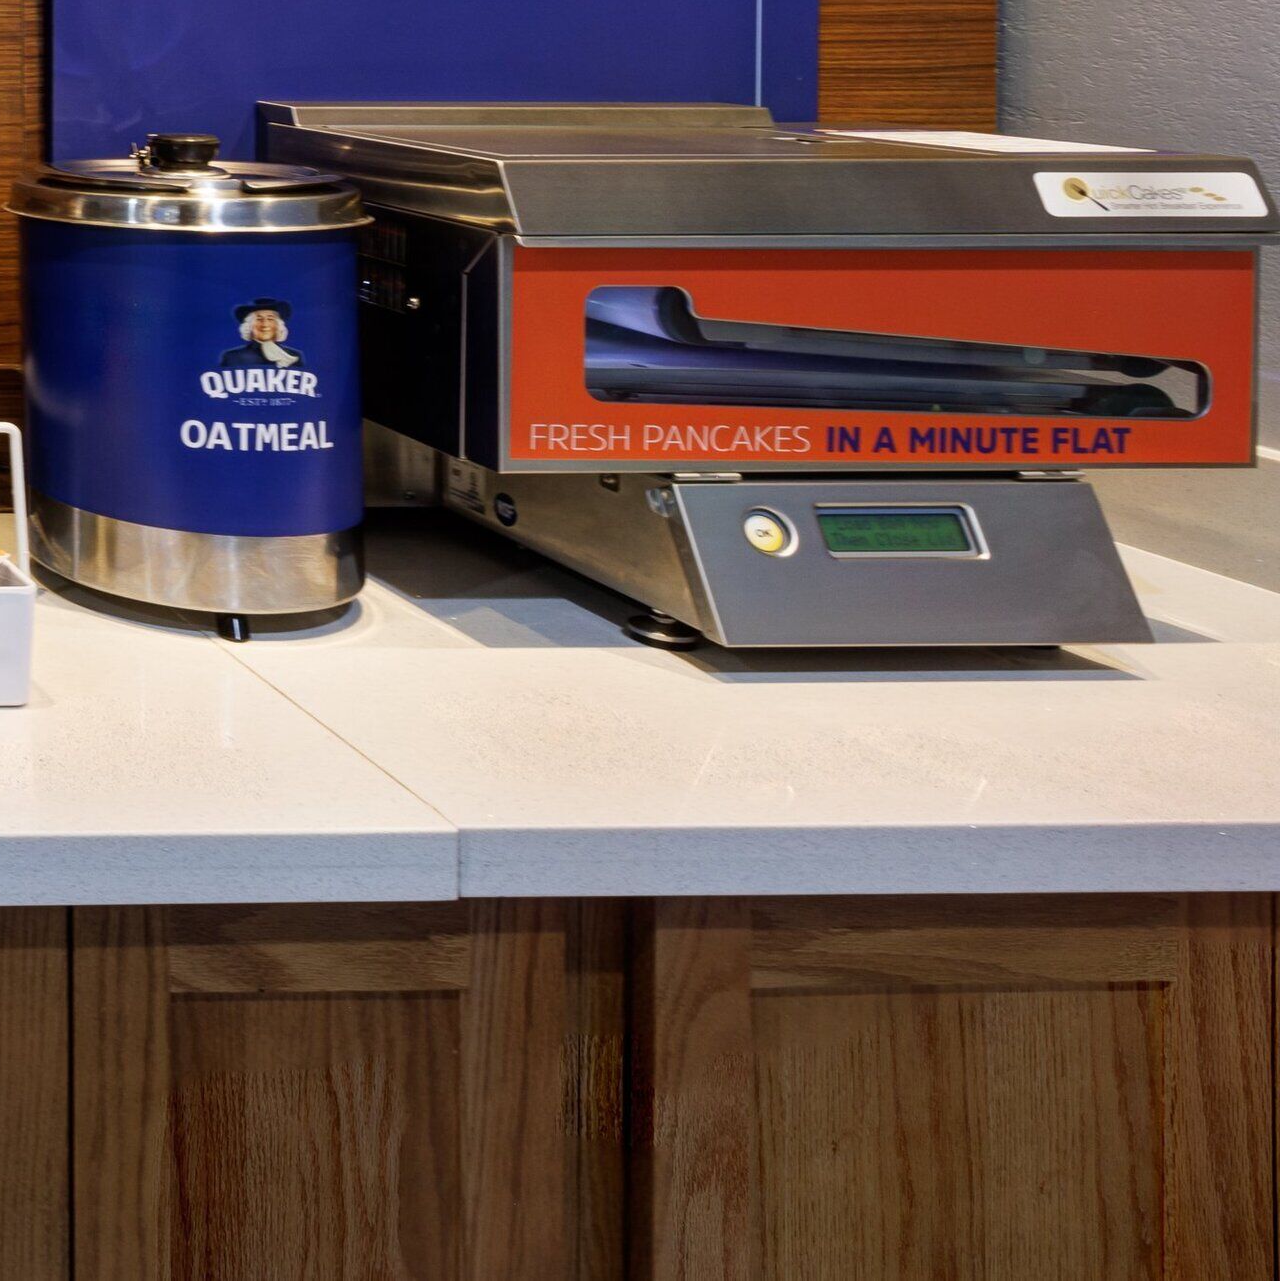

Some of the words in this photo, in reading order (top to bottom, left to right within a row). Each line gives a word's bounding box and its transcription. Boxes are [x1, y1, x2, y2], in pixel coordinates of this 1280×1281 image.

[199, 368, 318, 399] QUAKER
[179, 419, 335, 452] OATMEAL
[530, 423, 631, 451] FRESH
[642, 424, 811, 453] PANCAKES
[826, 426, 861, 453] IN
[873, 426, 897, 453] A
[908, 427, 1040, 454] MINUTE
[1051, 427, 1132, 455] FLAT
